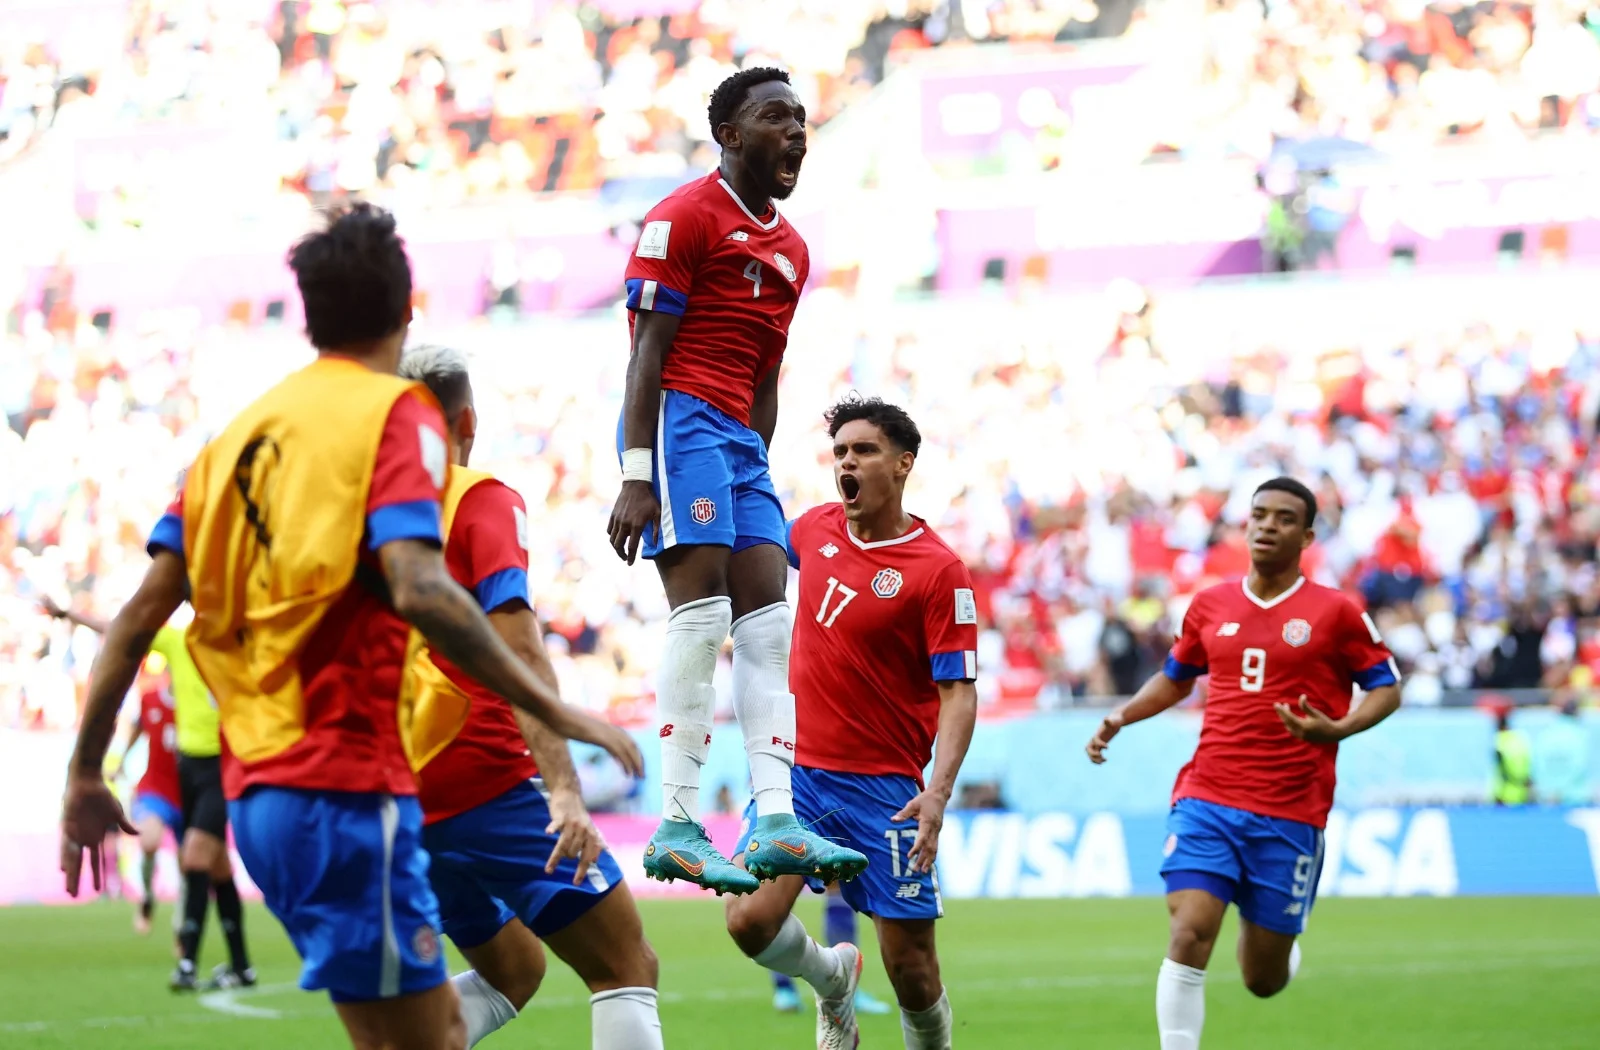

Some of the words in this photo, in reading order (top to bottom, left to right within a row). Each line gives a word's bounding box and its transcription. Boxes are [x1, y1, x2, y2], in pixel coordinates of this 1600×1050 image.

[743, 259, 763, 299] 4
[696, 503, 711, 520] CR
[815, 576, 859, 629] 17
[878, 571, 898, 593] CR
[1240, 647, 1267, 693] 9
[884, 829, 919, 878] 17
[938, 811, 1133, 897] VISA
[1318, 807, 1459, 896] ISA
[1291, 854, 1313, 897] 9
